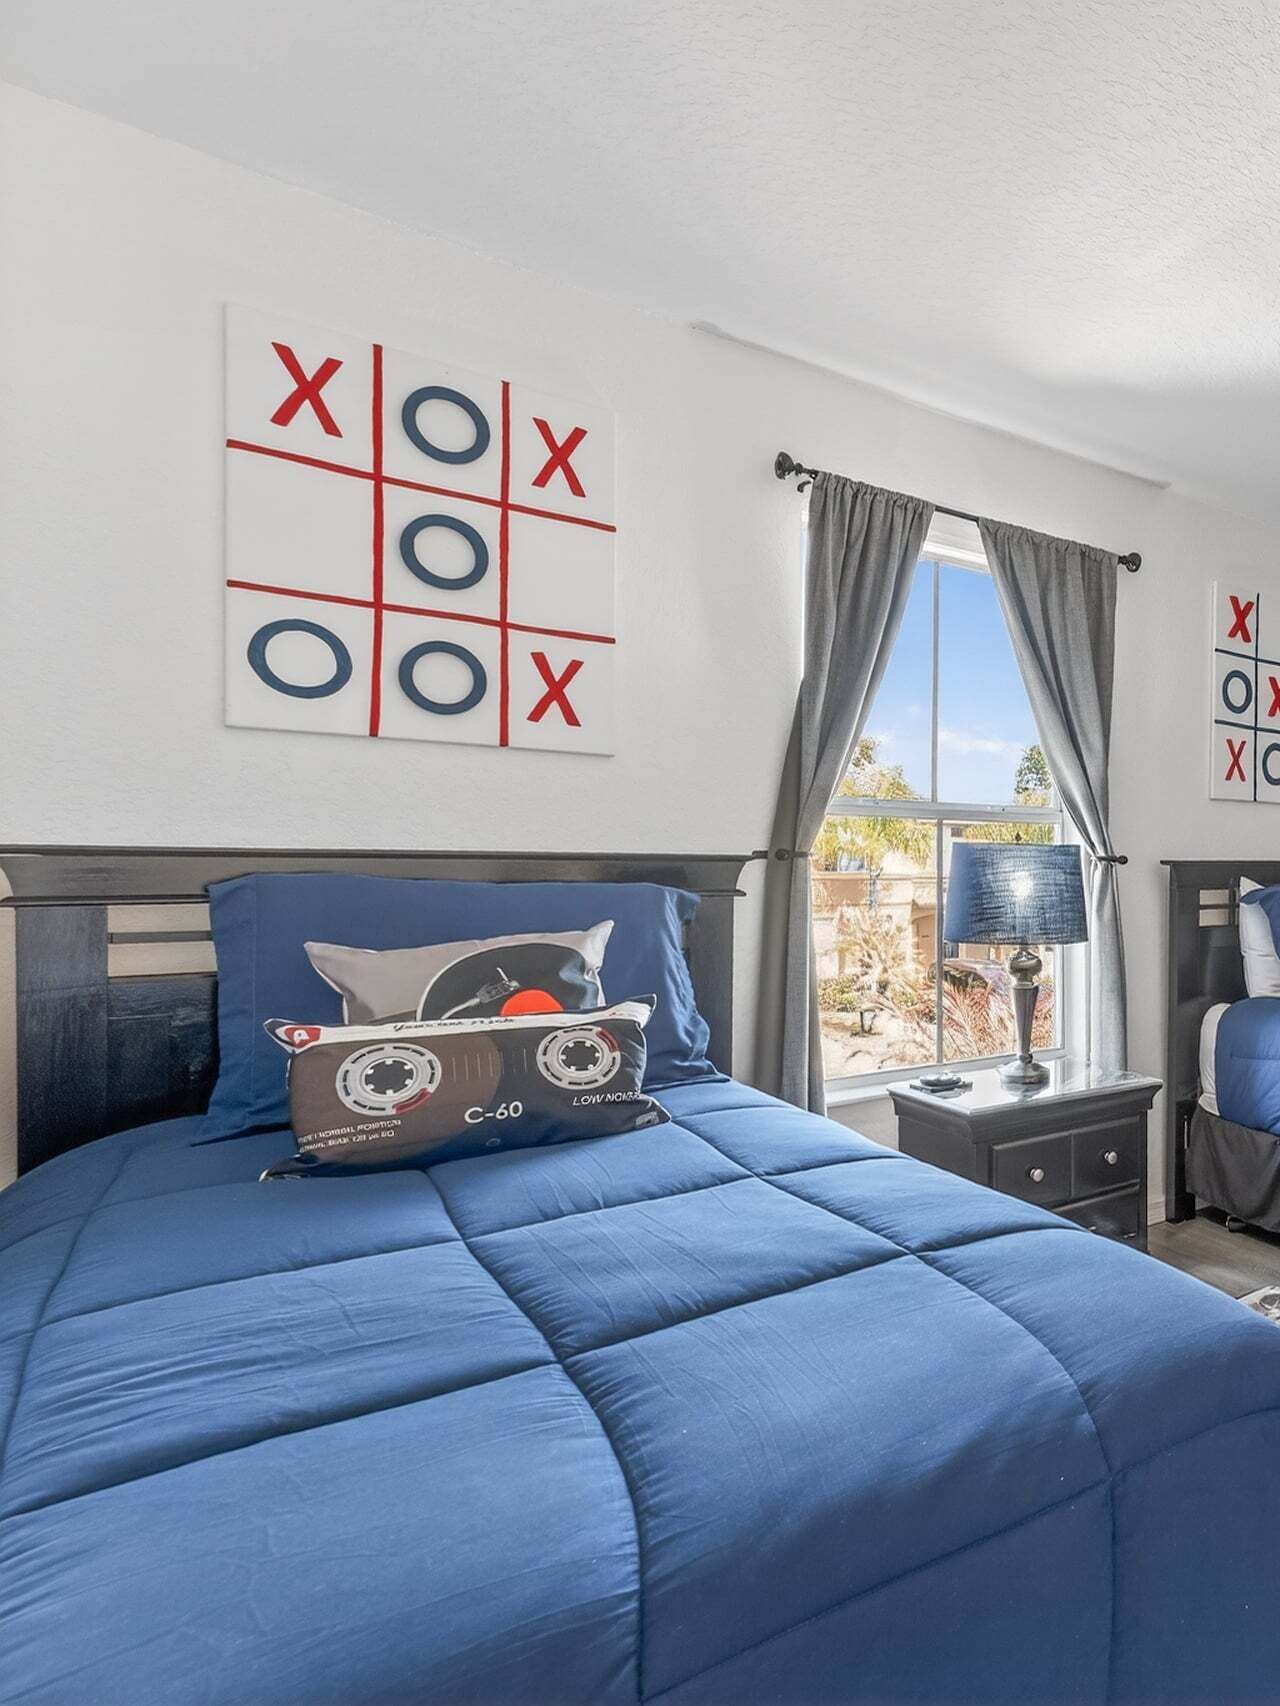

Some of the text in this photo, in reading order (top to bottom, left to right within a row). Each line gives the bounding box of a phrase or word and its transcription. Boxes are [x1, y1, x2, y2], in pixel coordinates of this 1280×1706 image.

[270, 341, 588, 498] X O X
[399, 514, 489, 590] O
[1227, 595, 1255, 643] X
[247, 618, 584, 727] O O X
[1222, 670, 1253, 714] O
[1225, 738, 1247, 782] X
[464, 1101, 523, 1124] C-60
[572, 1094, 604, 1106] LOW
